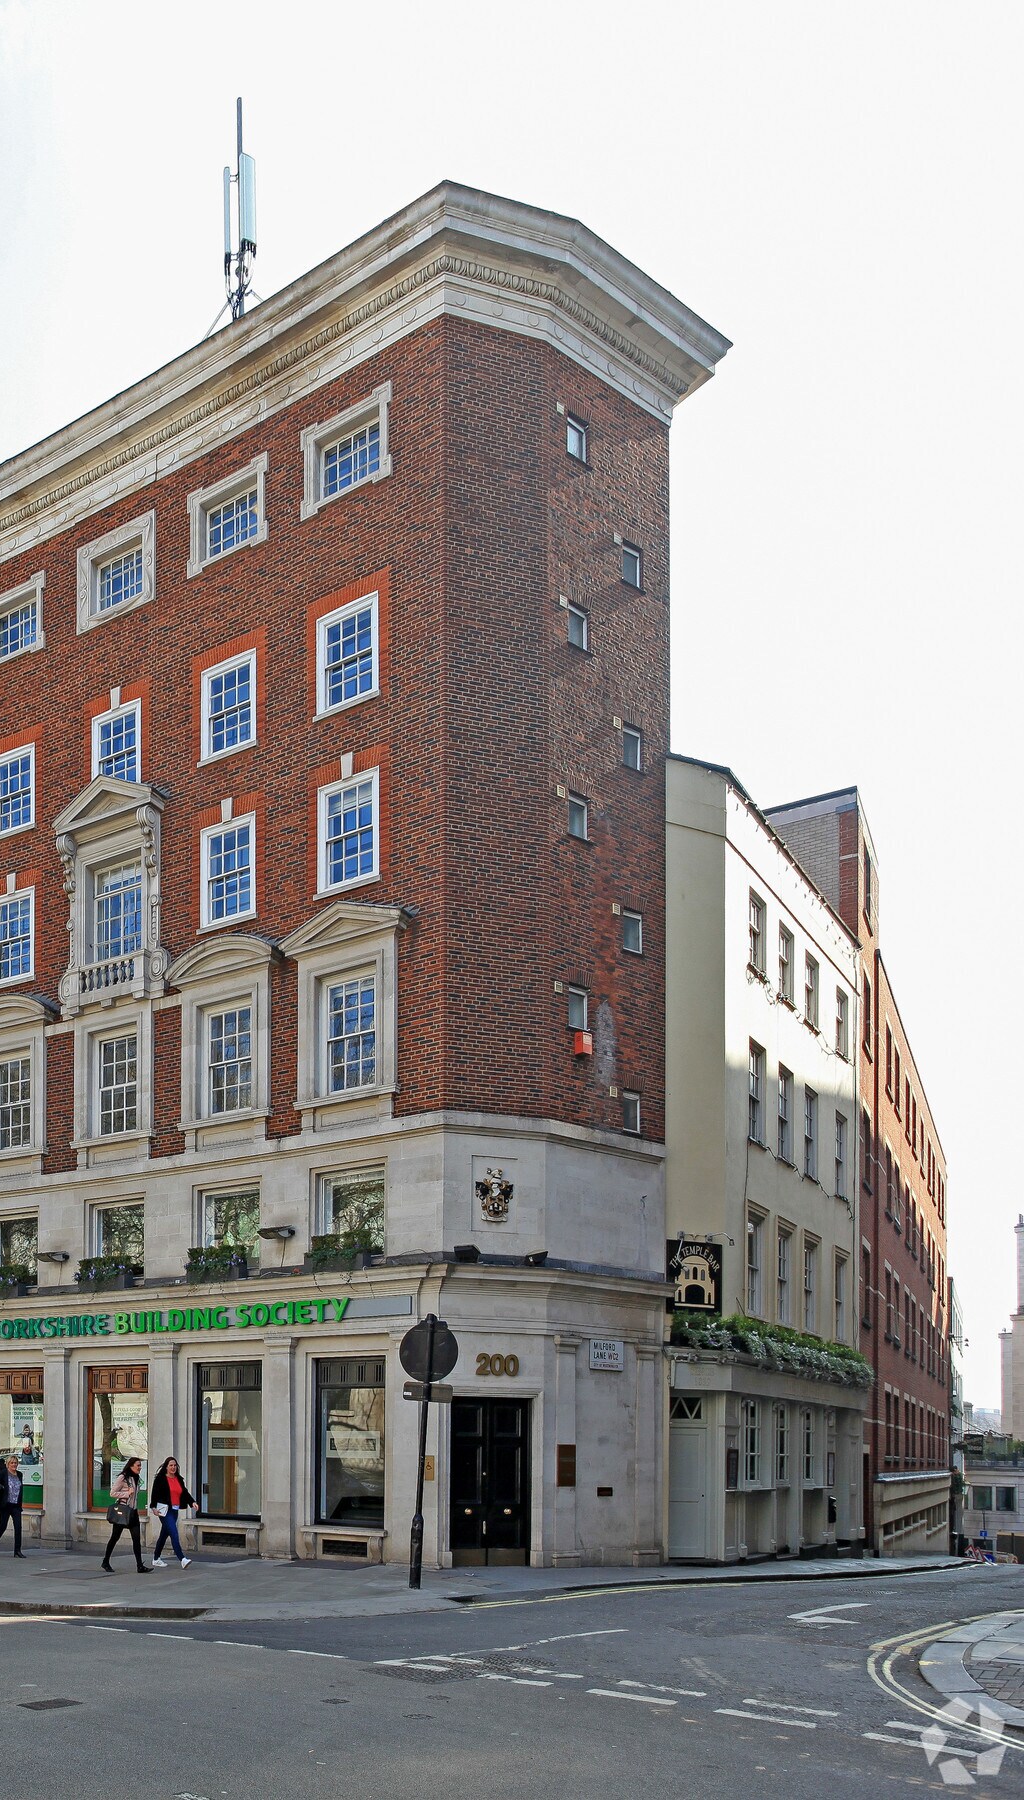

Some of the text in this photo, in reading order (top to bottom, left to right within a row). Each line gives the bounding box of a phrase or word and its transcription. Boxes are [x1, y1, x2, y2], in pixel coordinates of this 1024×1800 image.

[669, 1245, 720, 1272] THE TEMPLE BAR
[114, 1306, 228, 1335] BUILDING
[234, 1296, 351, 1328] SOCIETY
[593, 1342, 616, 1351] MILFORD
[593, 1351, 619, 1361] LANE WC2
[476, 1352, 520, 1377] 200
